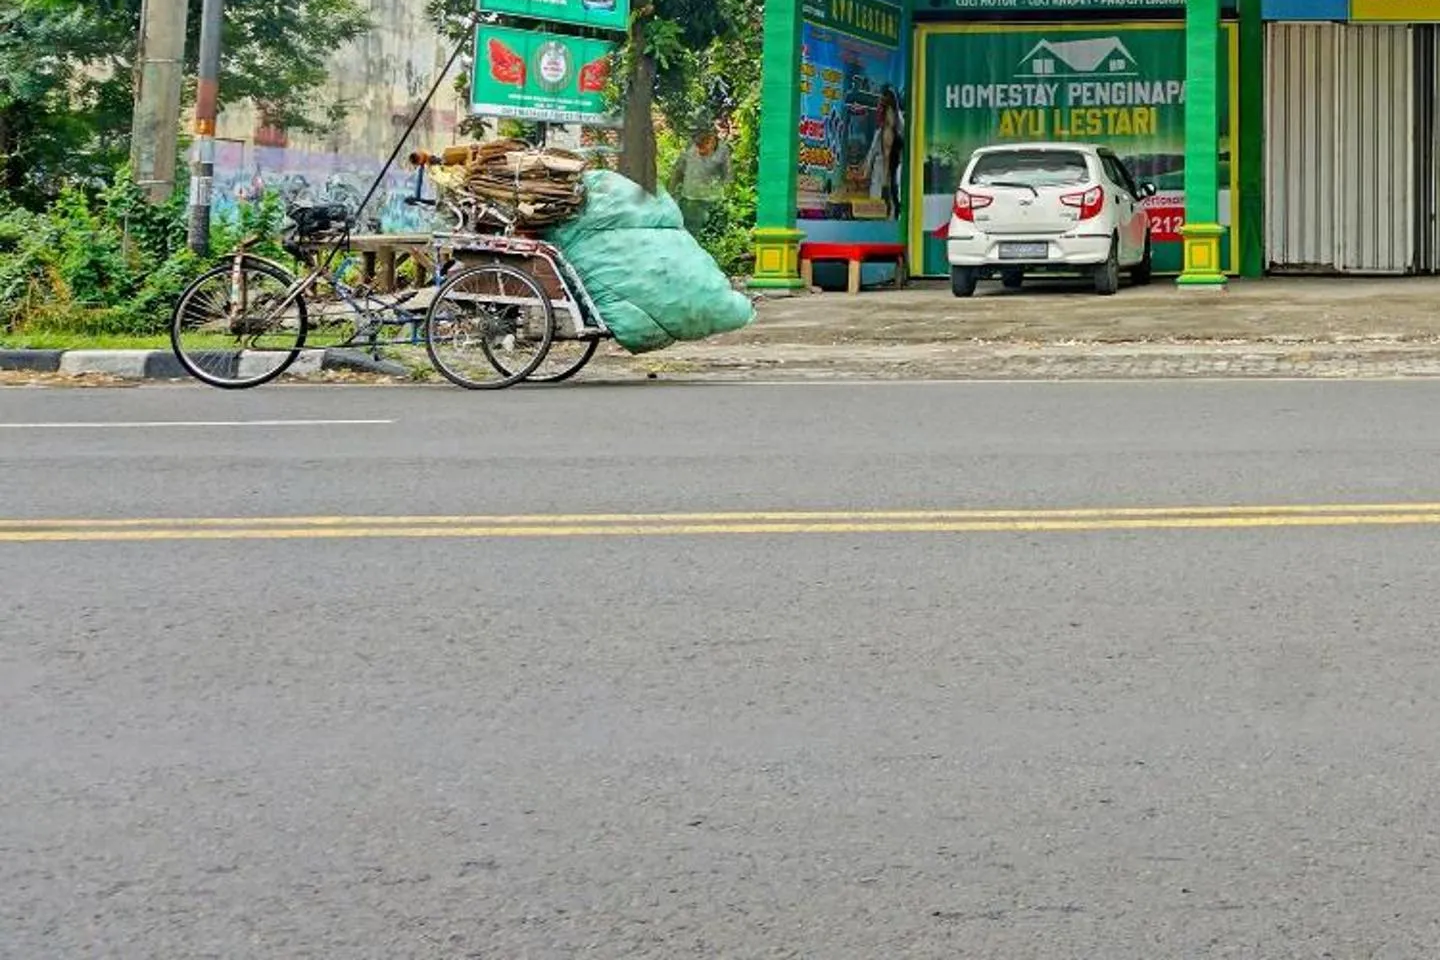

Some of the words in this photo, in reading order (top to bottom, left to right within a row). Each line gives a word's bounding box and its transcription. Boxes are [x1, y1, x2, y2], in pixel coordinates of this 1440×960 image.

[946, 84, 1058, 108] HOMESTAY
[1000, 109, 1045, 136] AYU
[1055, 107, 1157, 136] LESTARI
[1151, 216, 1184, 233] 212
